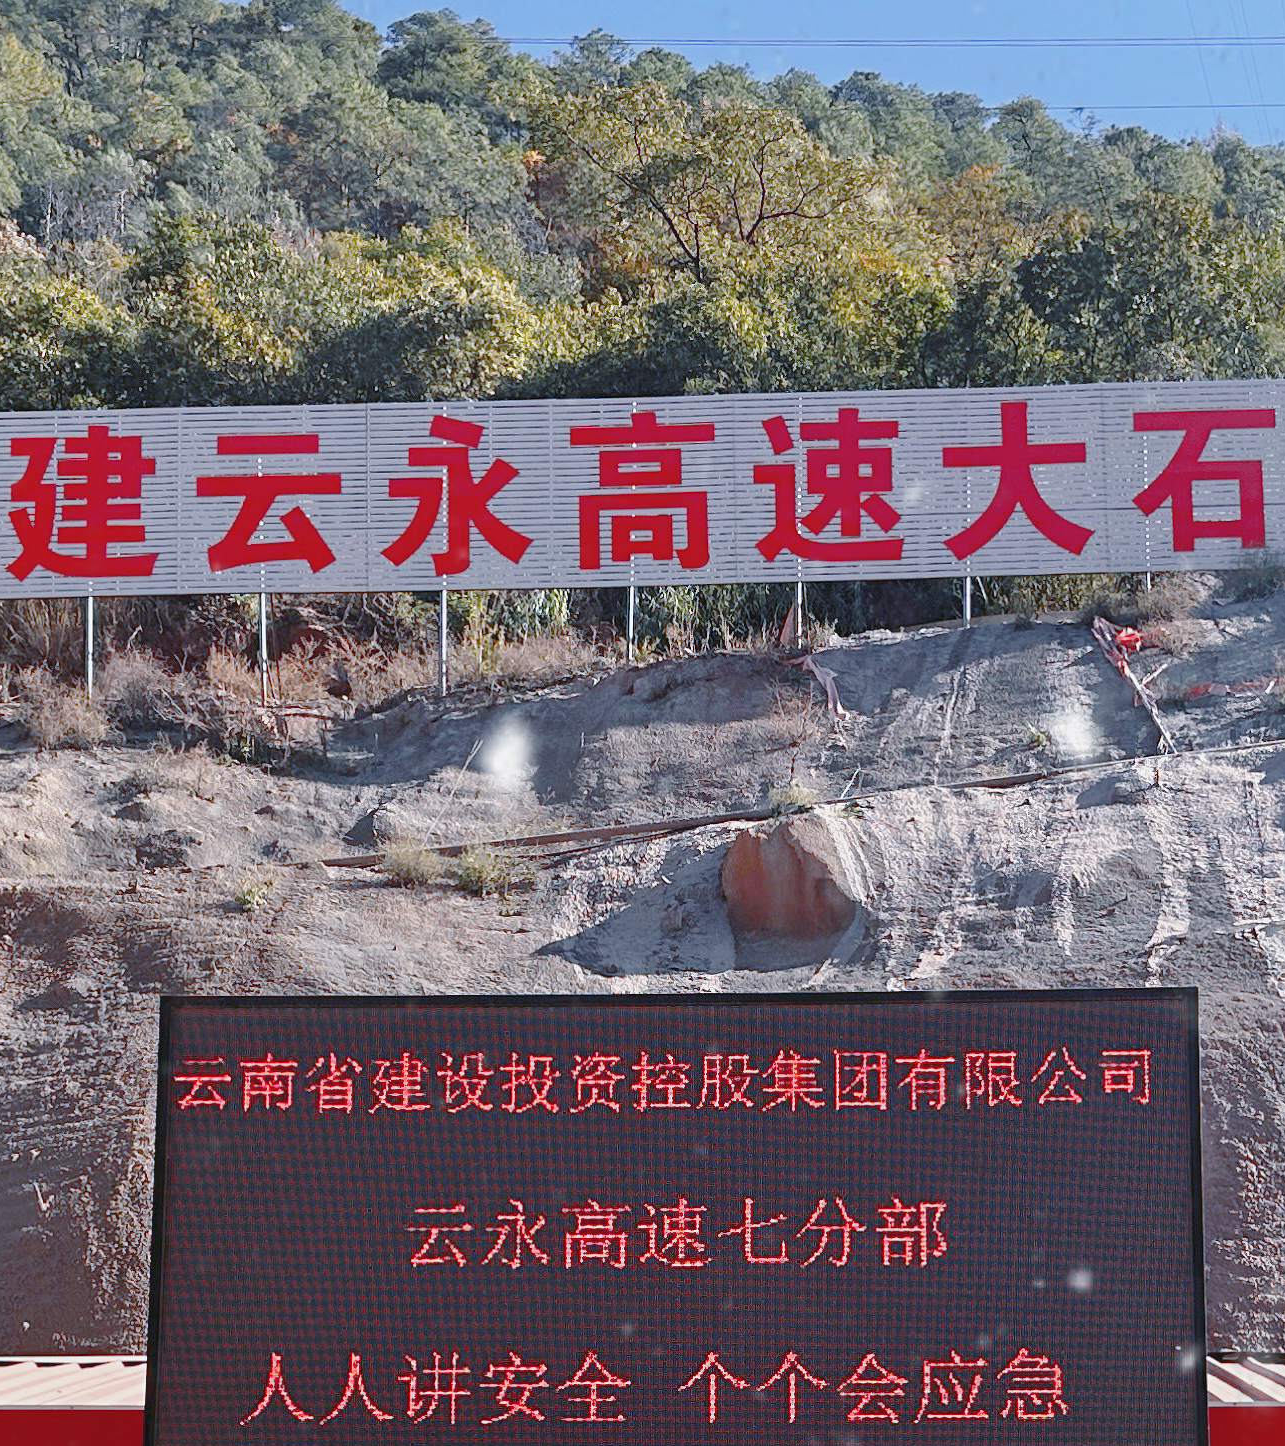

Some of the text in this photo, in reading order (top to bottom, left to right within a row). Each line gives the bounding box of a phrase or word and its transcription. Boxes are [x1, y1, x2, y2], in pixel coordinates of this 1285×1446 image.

[173, 1046, 1156, 1115] 云南省建设投资控股集团有限公司
[403, 1196, 949, 1270] 云永高速七分部
[238, 1346, 1071, 1426] 人人讲安全 个个会应急
